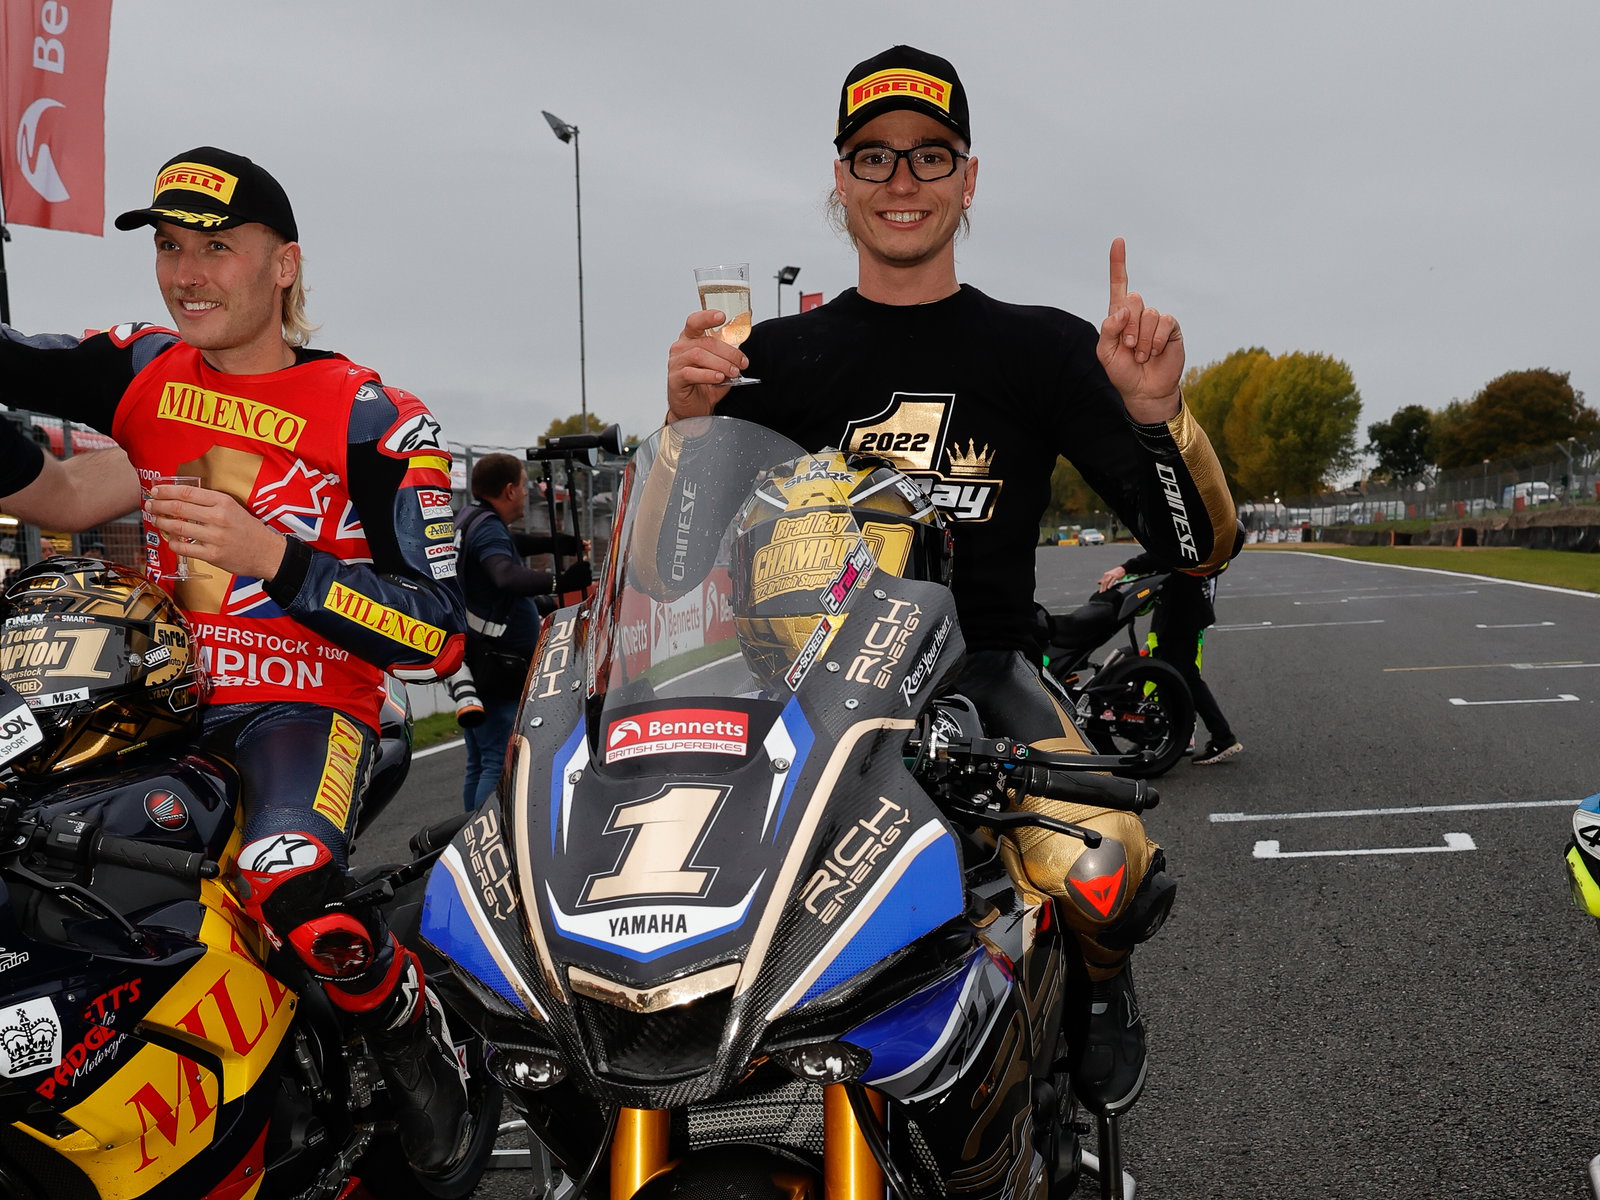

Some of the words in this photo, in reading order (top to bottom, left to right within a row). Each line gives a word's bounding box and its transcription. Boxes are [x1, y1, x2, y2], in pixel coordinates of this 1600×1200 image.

[848, 73, 945, 106] PIRELLI
[157, 167, 226, 193] PIRELLI
[160, 386, 299, 444] MILENCO
[859, 432, 930, 452] 2022
[783, 471, 857, 490] SHARK
[671, 479, 698, 583] DAINESE
[773, 520, 810, 541] Brad
[812, 514, 851, 534] Ray
[1155, 462, 1199, 561] DAINESE
[754, 535, 876, 586] CHAMPIO
[6, 613, 47, 628] FINLAY
[7, 626, 48, 645] Todd
[157, 629, 186, 649] Shred
[329, 586, 442, 653] MILENCO
[668, 602, 700, 640] Bennetts
[845, 598, 911, 685] RICH
[45, 629, 110, 679] 1
[145, 646, 171, 665] SHOEI
[539, 617, 577, 698] RICH
[873, 603, 923, 690] ENERGY
[52, 692, 81, 704] Max
[899, 660, 925, 708] Revs
[922, 640, 943, 676] Your
[608, 745, 653, 760] BRITISH
[656, 741, 742, 753] SUPERBIKES
[649, 720, 743, 737] Bennetts
[317, 718, 362, 824] MILENCO
[156, 813, 186, 823] HONDA
[474, 809, 520, 914] RICH
[587, 788, 721, 901] 1
[797, 796, 901, 914] RICH
[818, 808, 910, 924] ENERGY
[463, 825, 507, 921] ENERGY
[609, 914, 688, 937] YAMAHA
